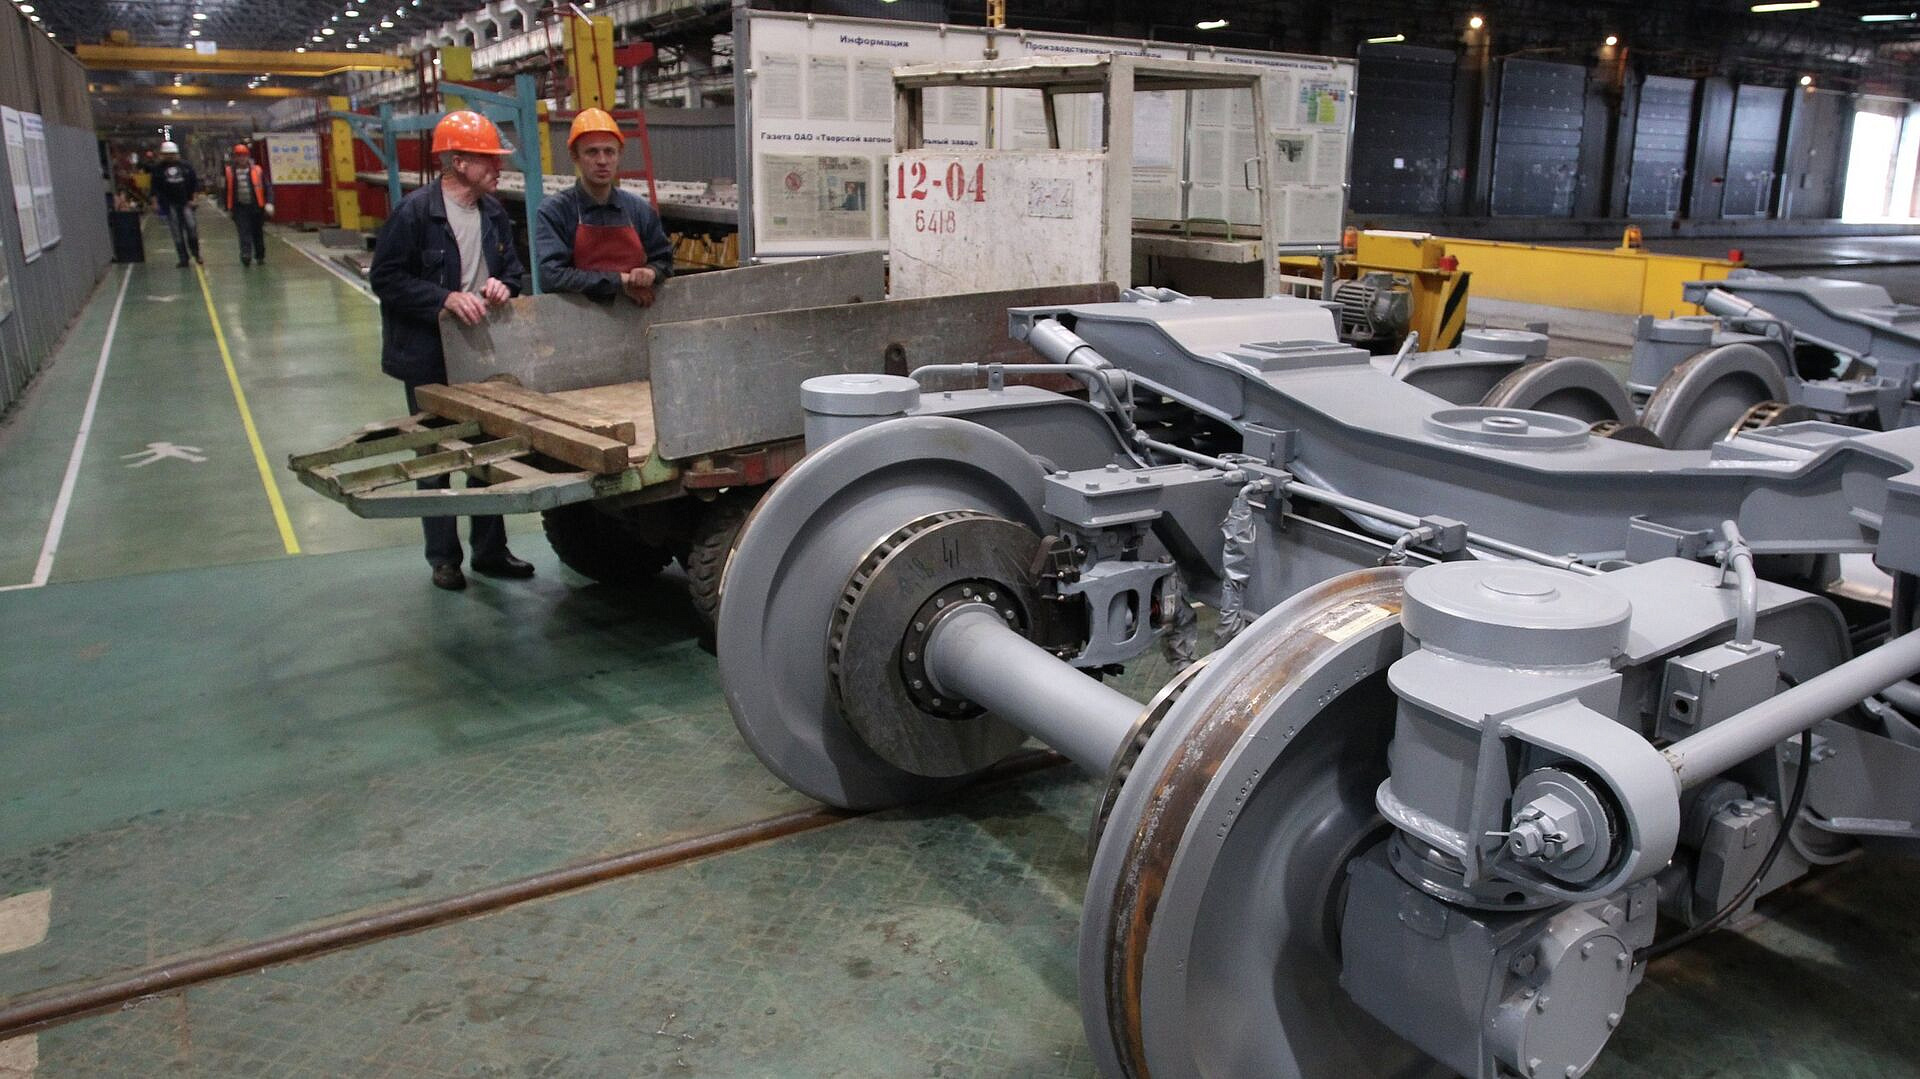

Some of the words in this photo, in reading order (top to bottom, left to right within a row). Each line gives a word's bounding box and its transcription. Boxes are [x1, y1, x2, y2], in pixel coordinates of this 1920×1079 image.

[840, 34, 909, 47] Информация
[760, 132, 791, 141] Газета
[794, 133, 813, 141] ОАО
[816, 133, 861, 143] «Тверской
[896, 161, 987, 203] 12-04
[915, 209, 957, 234] 6418
